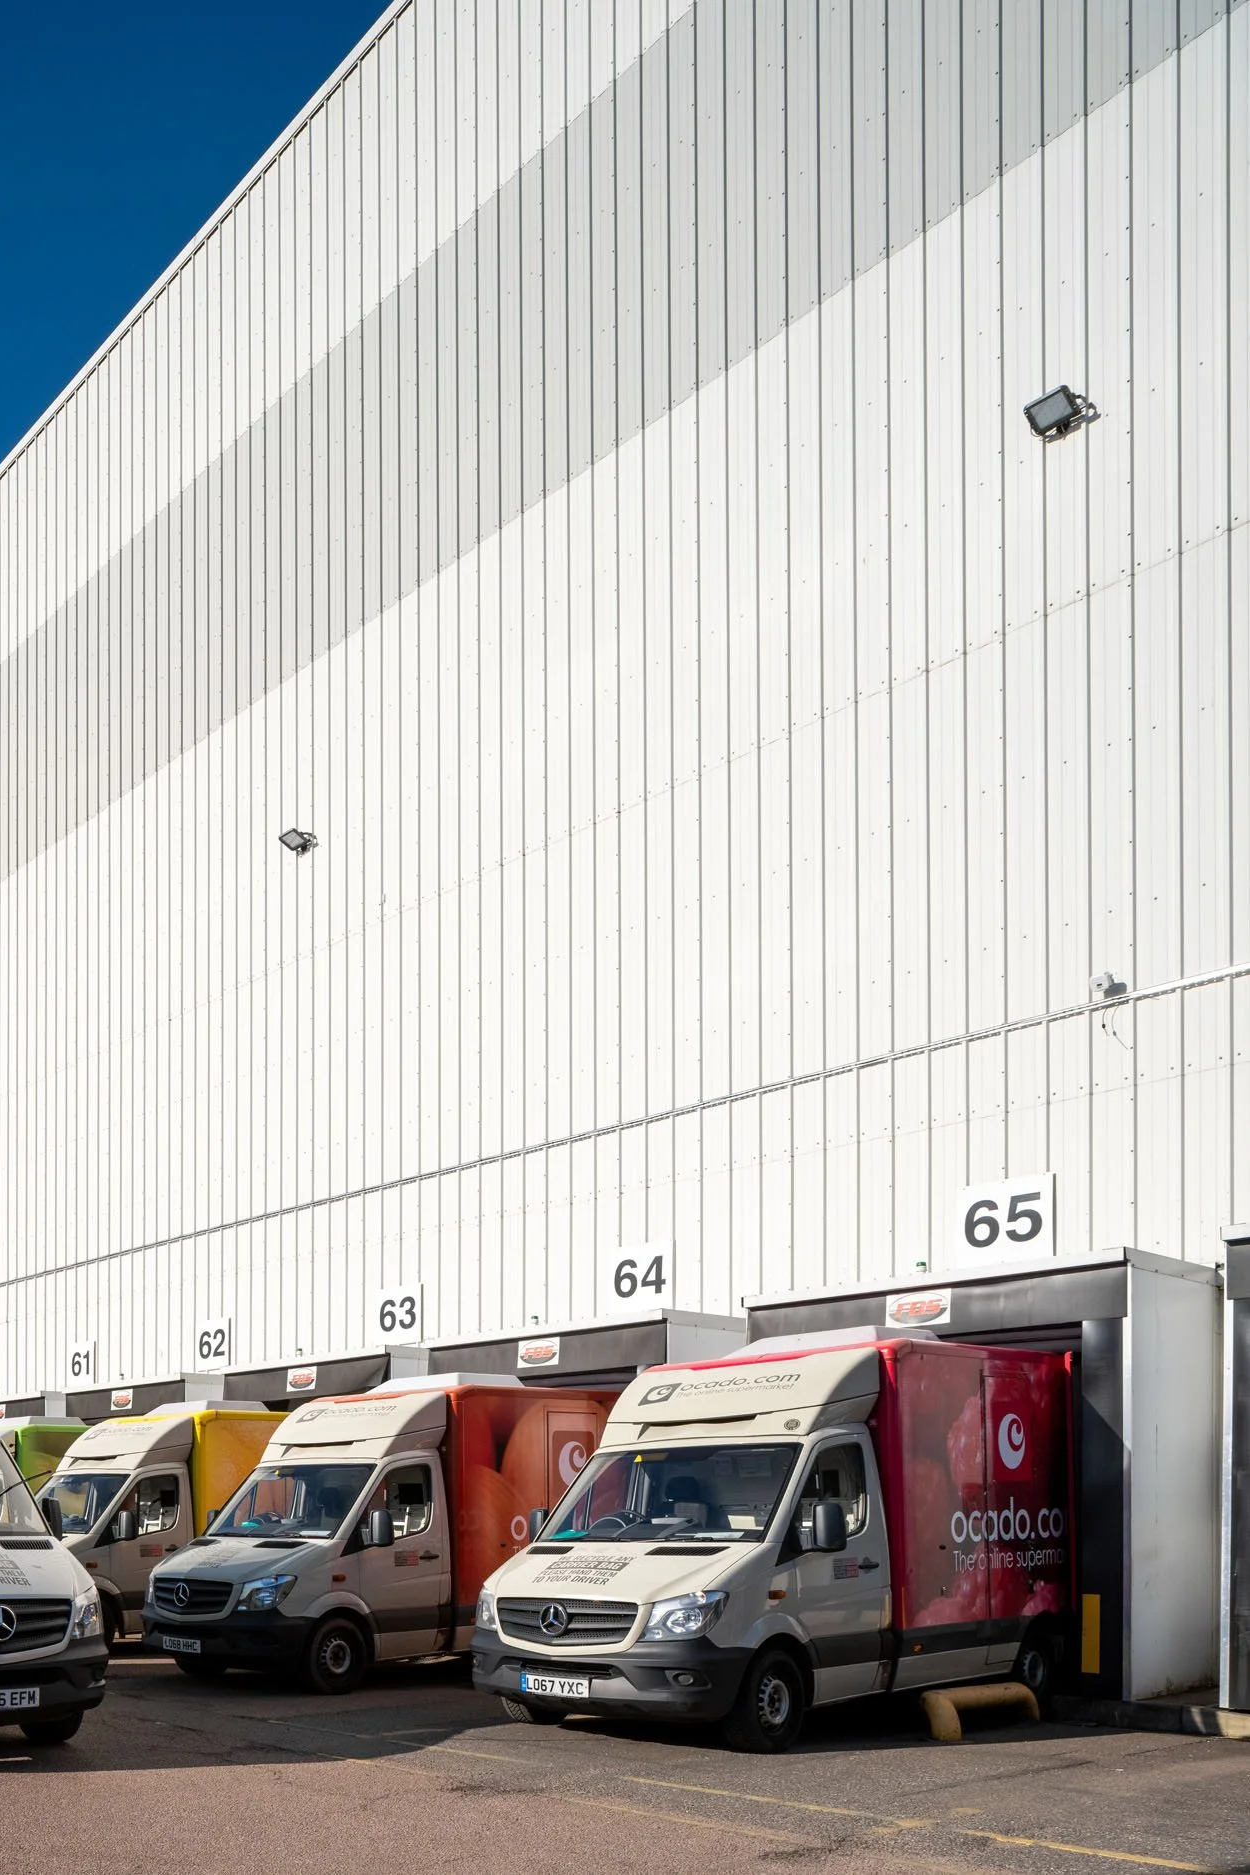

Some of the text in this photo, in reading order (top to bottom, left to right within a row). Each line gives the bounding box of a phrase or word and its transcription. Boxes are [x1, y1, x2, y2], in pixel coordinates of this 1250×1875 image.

[964, 1191, 1043, 1248] 65
[614, 1255, 666, 1298] 64
[379, 1296, 416, 1332] 63
[894, 1299, 943, 1318] FBS
[199, 1328, 226, 1359] 62
[523, 1345, 554, 1360] FBS
[71, 1350, 90, 1377] 61
[680, 1373, 801, 1391] ocado.com
[694, 1387, 725, 1396] online
[727, 1383, 795, 1394] supermarket
[951, 1497, 1065, 1543] ocado.co
[551, 1561, 623, 1569] CARRIER BAG
[953, 1550, 975, 1572] The
[978, 1548, 1014, 1571] online
[0, 1569, 26, 1577] THEM
[570, 1575, 610, 1586] DRIVER
[592, 1570, 618, 1578] THEM
[526, 1677, 584, 1695] LO67 YXC
[10, 1690, 36, 1706] EFM
